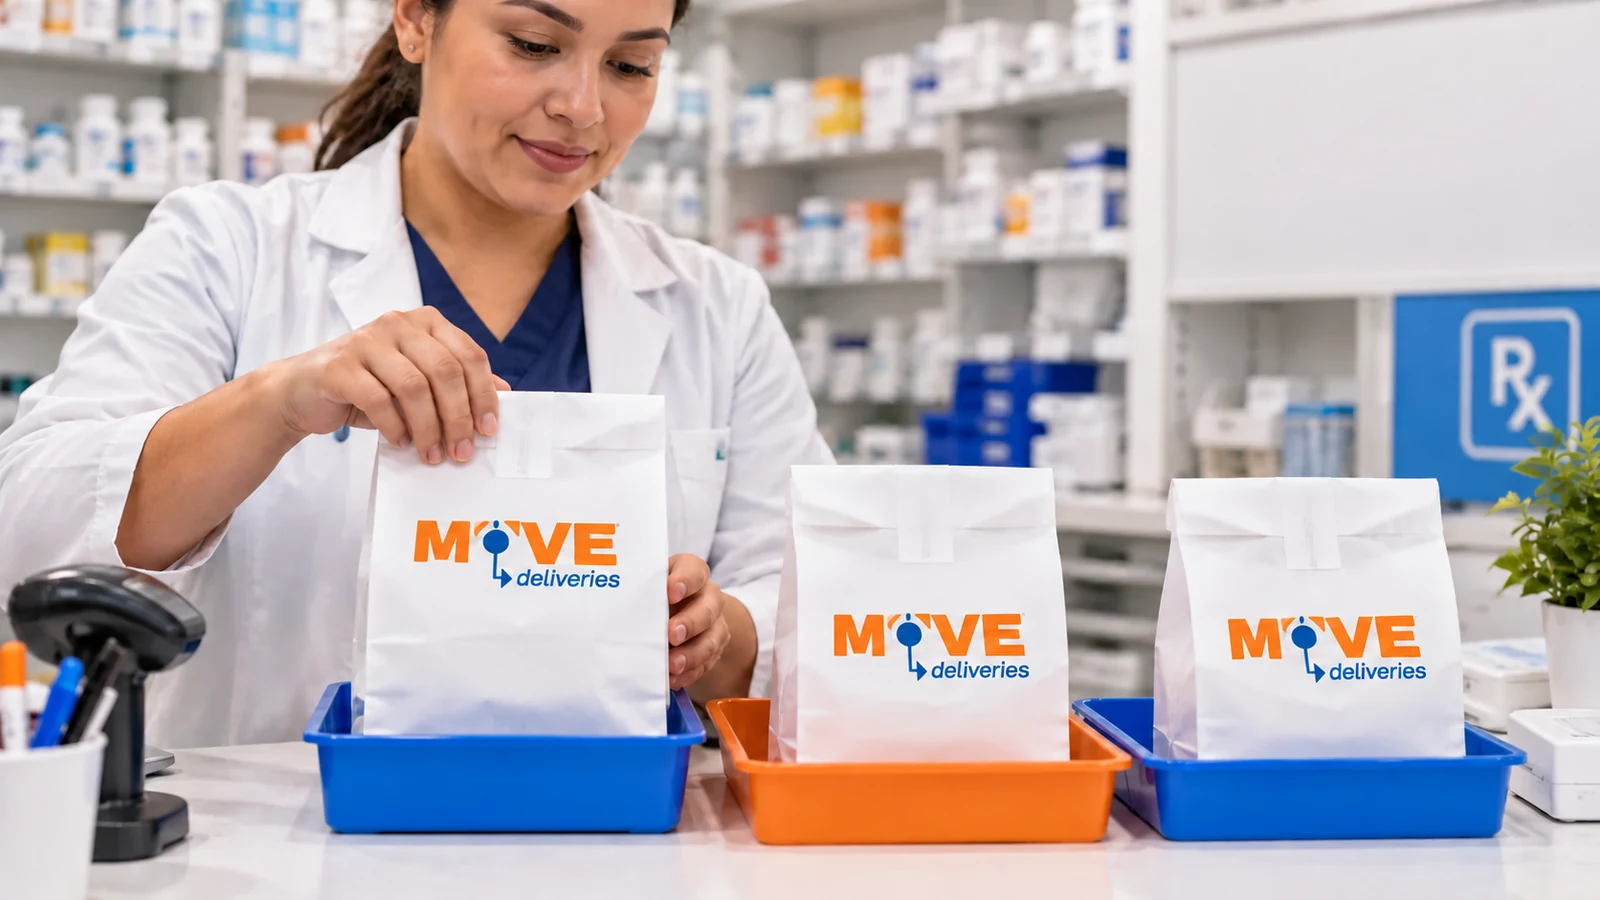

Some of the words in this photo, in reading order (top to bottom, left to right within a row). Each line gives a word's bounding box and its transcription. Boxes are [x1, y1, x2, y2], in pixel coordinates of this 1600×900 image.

[516, 568, 621, 588] deliveries
[931, 661, 1030, 679] deliveries
[1329, 662, 1427, 681] deliveries
